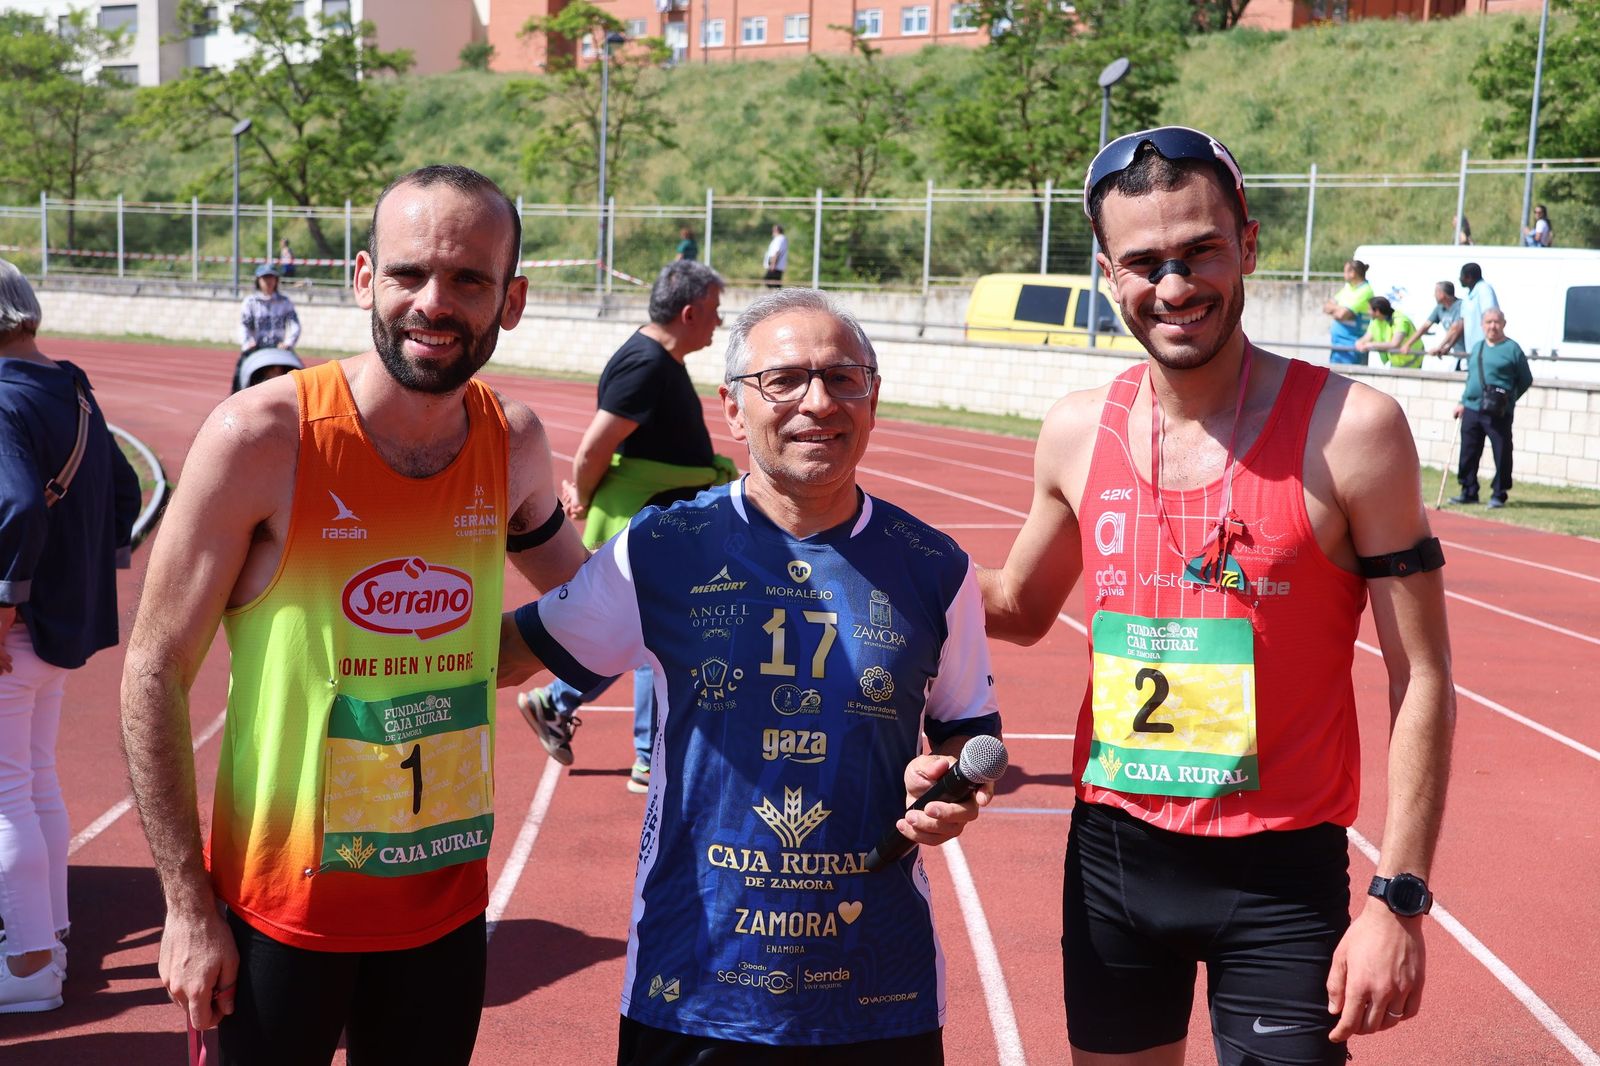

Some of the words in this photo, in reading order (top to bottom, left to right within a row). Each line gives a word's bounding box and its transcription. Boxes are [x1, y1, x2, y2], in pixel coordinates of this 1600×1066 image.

[1100, 488, 1133, 501] 42K
[690, 581, 748, 594] MERCURY
[765, 586, 833, 600] MORALEJO
[1238, 576, 1291, 597] ribe
[356, 580, 469, 616] Serrano
[689, 604, 750, 617] ANGEL
[692, 617, 744, 628] OPTICO
[759, 608, 838, 679] 17
[852, 624, 908, 647] ZAMORA
[1151, 639, 1199, 651] RURAL
[384, 656, 419, 676] BIEN
[425, 655, 433, 674] Y
[1132, 667, 1175, 734] 2
[384, 717, 413, 733] CAJA
[415, 709, 452, 727] RURAL
[762, 728, 828, 761] gaza
[400, 743, 423, 816] 1
[1124, 762, 1173, 782] CAJA
[1178, 765, 1249, 785] RURAL
[379, 843, 427, 864] CAJA
[430, 830, 488, 857] RURAL
[707, 844, 772, 873] CAJA
[780, 852, 871, 876] RURAL
[744, 876, 765, 888] DE
[770, 877, 835, 890] ZAMORA
[735, 907, 838, 937] ZAMORA
[766, 944, 805, 954] ENAMORA
[803, 967, 850, 983] Senda
